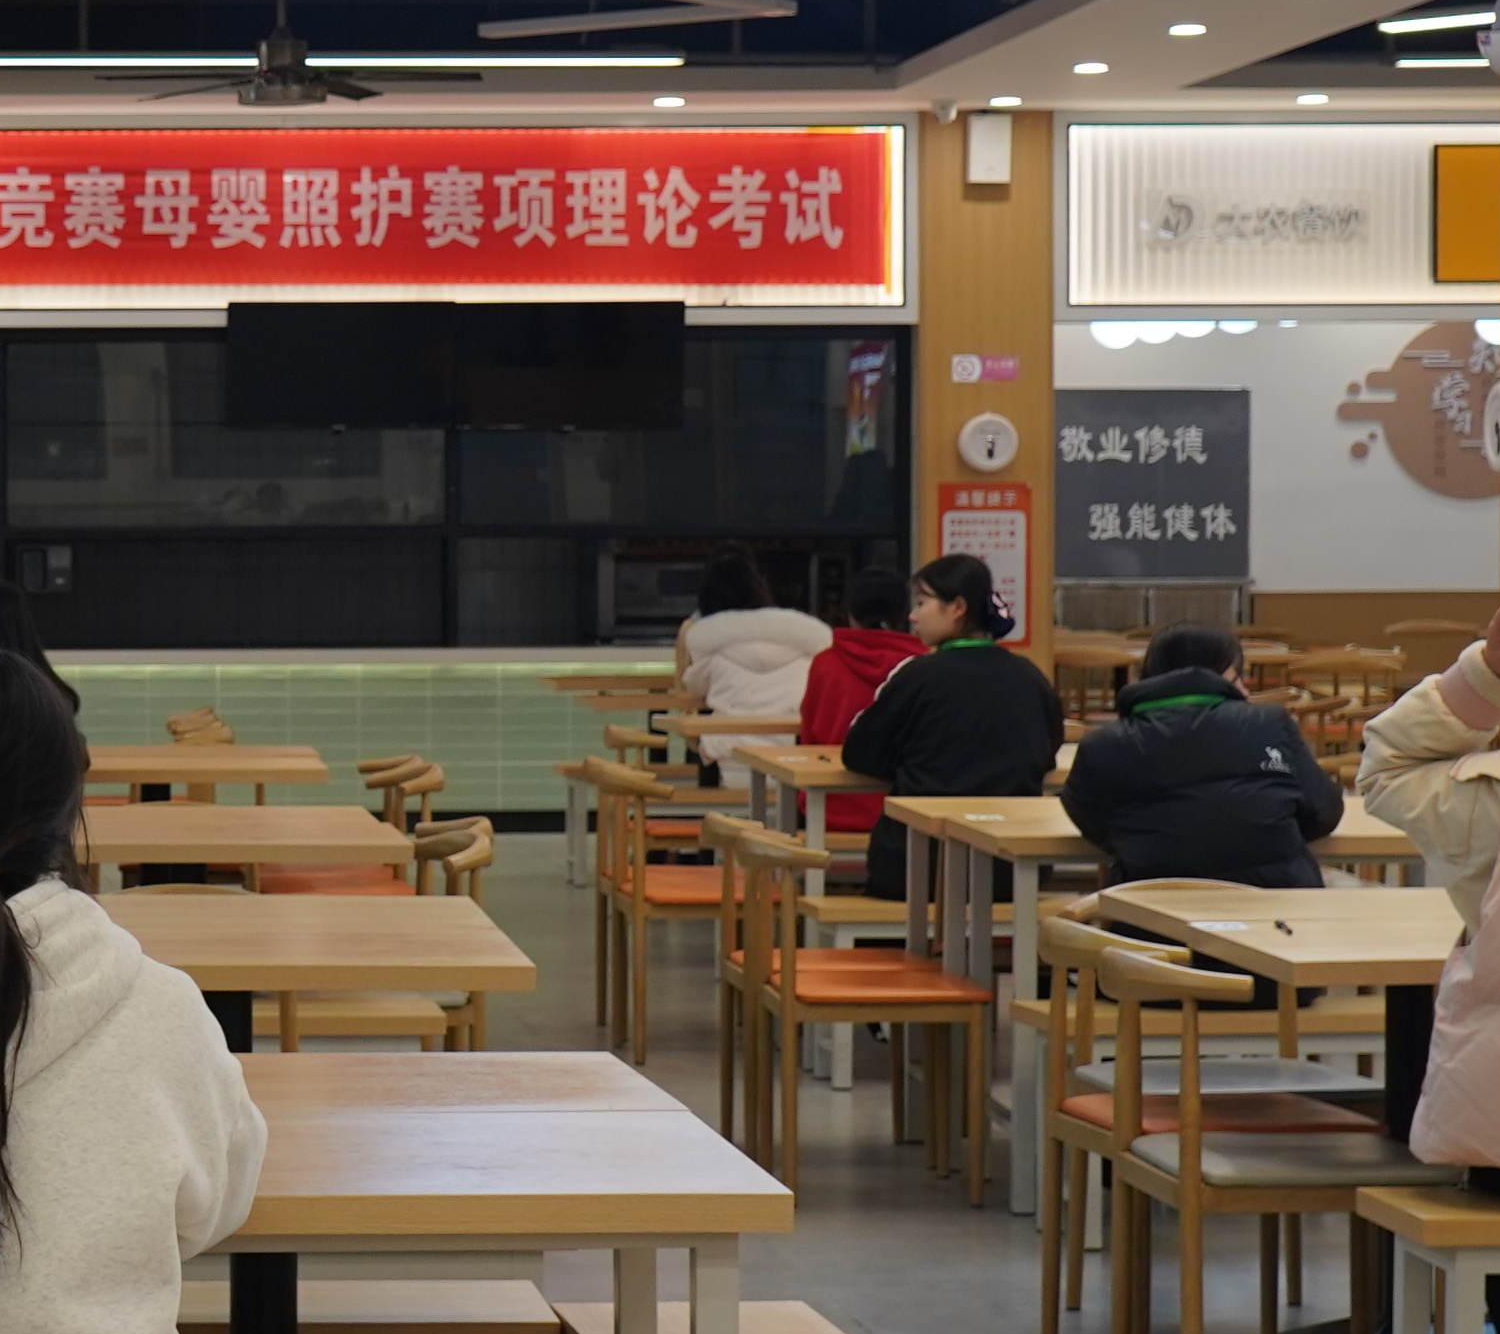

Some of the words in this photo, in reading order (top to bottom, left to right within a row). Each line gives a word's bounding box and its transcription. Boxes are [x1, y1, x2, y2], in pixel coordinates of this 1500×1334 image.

[1058, 424, 1209, 465] 敬业修德
[1087, 501, 1238, 543] 强能健体
